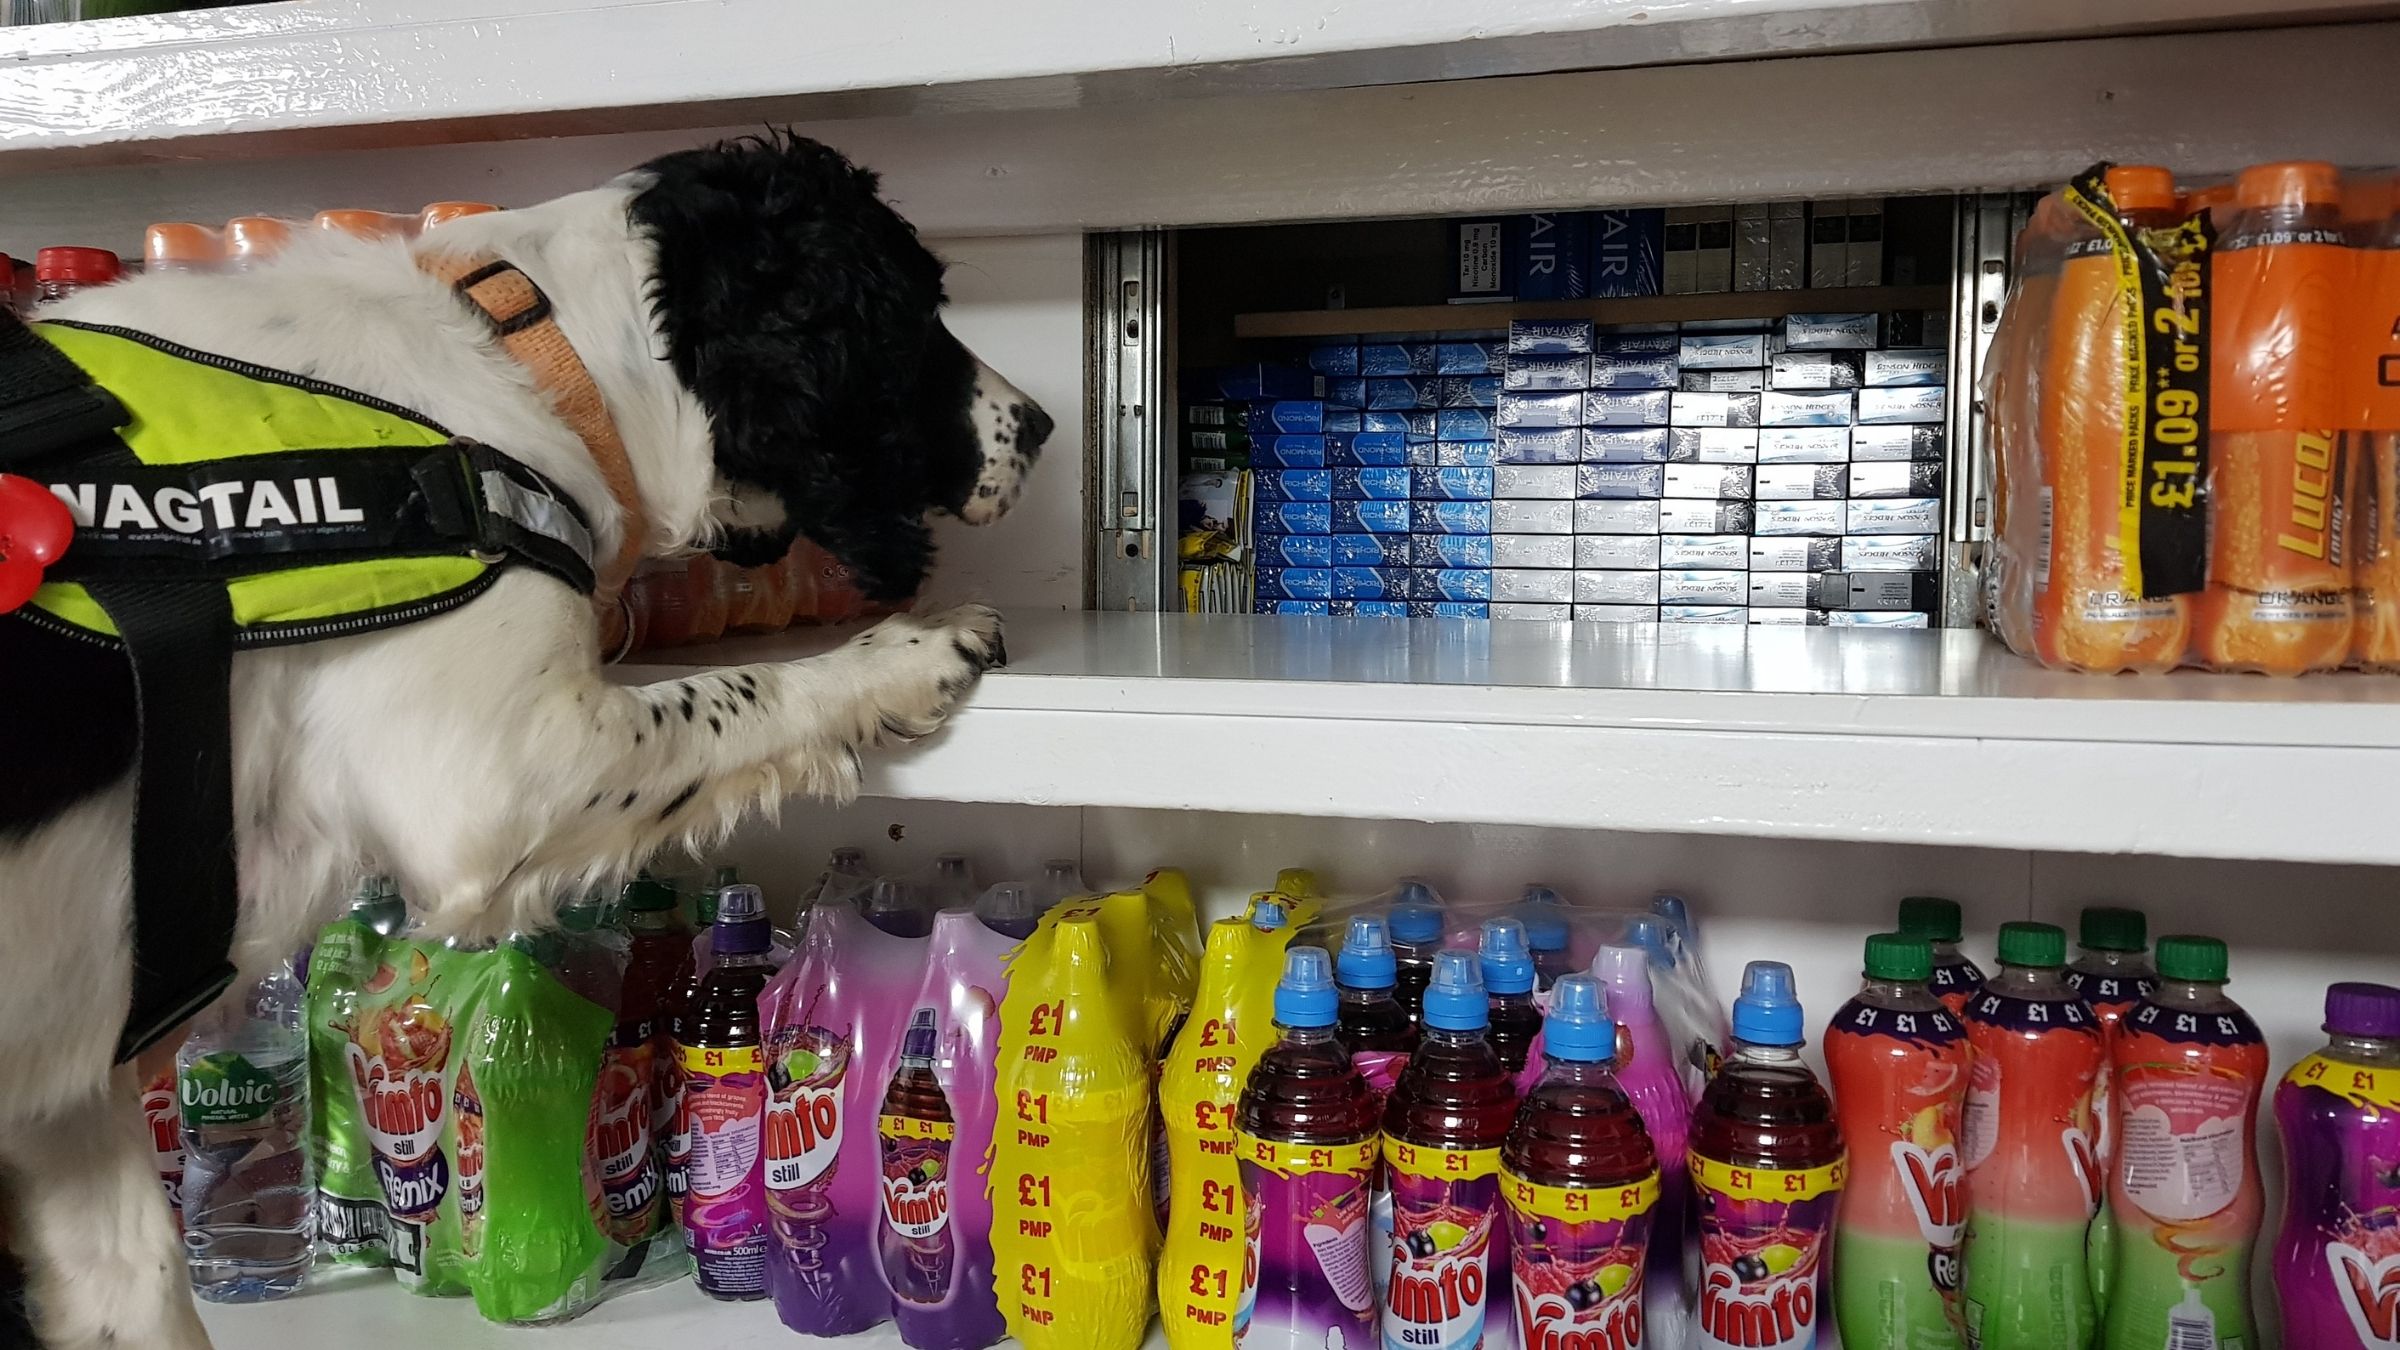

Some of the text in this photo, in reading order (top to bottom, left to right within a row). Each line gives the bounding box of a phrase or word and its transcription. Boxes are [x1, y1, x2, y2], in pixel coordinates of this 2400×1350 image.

[1473, 227, 1480, 241] mg
[1491, 225, 1498, 238] mg
[1529, 213, 1556, 276] AIR
[1602, 209, 1630, 278] AIR
[2154, 306, 2200, 333] 2
[2174, 341, 2200, 372] or
[2129, 365, 2141, 393] PRICE
[2125, 405, 2140, 508] PRICE MARKED PACKS
[2277, 429, 2332, 560] Luco
[2330, 496, 2344, 566] ENERGY
[1285, 579, 1328, 587] RICHMOND
[1936, 968, 1955, 985] £1
[2100, 979, 2119, 996] £1
[1980, 996, 2001, 1015] £1
[2028, 1003, 2049, 1022] £1
[2065, 1003, 2083, 1023] £1
[2137, 1005, 2159, 1024] £1
[1029, 999, 1065, 1037] £1
[1855, 1006, 1877, 1028] £1
[1896, 1014, 1917, 1033] £1
[1932, 1012, 1953, 1032] £1
[2176, 1013, 2197, 1034] £1
[2217, 1015, 2239, 1035] £1
[1200, 1018, 1237, 1049] £1
[704, 1050, 724, 1067] £1
[1023, 1045, 1058, 1064] PMP
[1195, 1056, 1236, 1073] PMP
[2306, 1062, 2329, 1080] £1
[2352, 1071, 2375, 1091] £1
[182, 1078, 272, 1108] Volvic
[352, 1052, 443, 1136] Vimto
[1017, 1089, 1048, 1125] £1
[1195, 1100, 1235, 1132] £1
[893, 1117, 933, 1134] £1 £1
[394, 1139, 415, 1156] still
[1018, 1129, 1050, 1149] PMP
[606, 1153, 634, 1175] still
[1256, 1142, 1276, 1162] £1
[1309, 1149, 1333, 1168] £1
[1397, 1145, 1469, 1171] £1 £1
[772, 1163, 801, 1184] still
[1730, 1169, 1753, 1190] £1
[1784, 1173, 1806, 1192] £1
[380, 1160, 444, 1210] Remix
[606, 1157, 659, 1214] emix
[1018, 1173, 1051, 1208] £1
[883, 1182, 947, 1225] Vimto
[1202, 1179, 1235, 1216] £1
[1516, 1183, 1641, 1212] £1 £1 £1
[911, 1224, 932, 1236] still
[1019, 1219, 1052, 1239] PMP
[1200, 1222, 1233, 1243] PMP
[733, 1244, 759, 1256] 500ml
[1021, 1263, 1051, 1298] £1
[1190, 1264, 1227, 1299] £1
[1021, 1303, 1054, 1326] PMP
[1186, 1304, 1227, 1326] PMP
[1401, 1327, 1440, 1346] still
